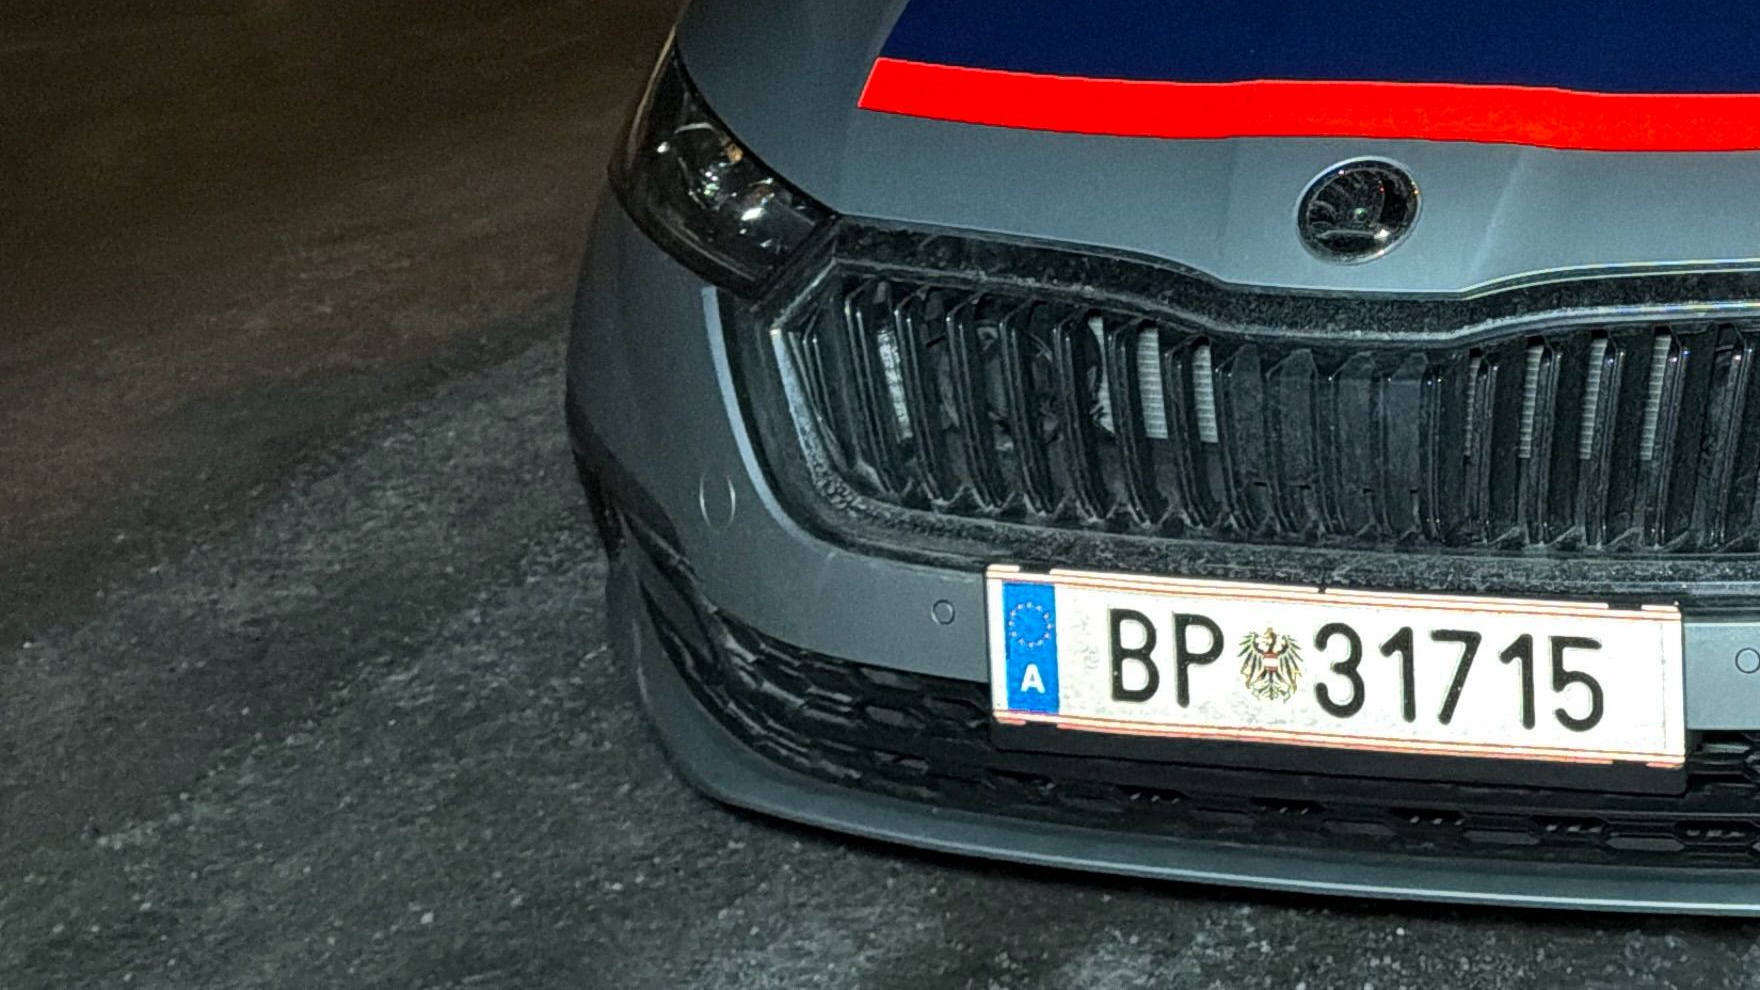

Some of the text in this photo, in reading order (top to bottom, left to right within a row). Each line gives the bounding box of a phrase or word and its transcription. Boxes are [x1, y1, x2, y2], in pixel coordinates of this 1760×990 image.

[1020, 663, 1046, 694] A
[1108, 608, 1604, 732] BP 31715
